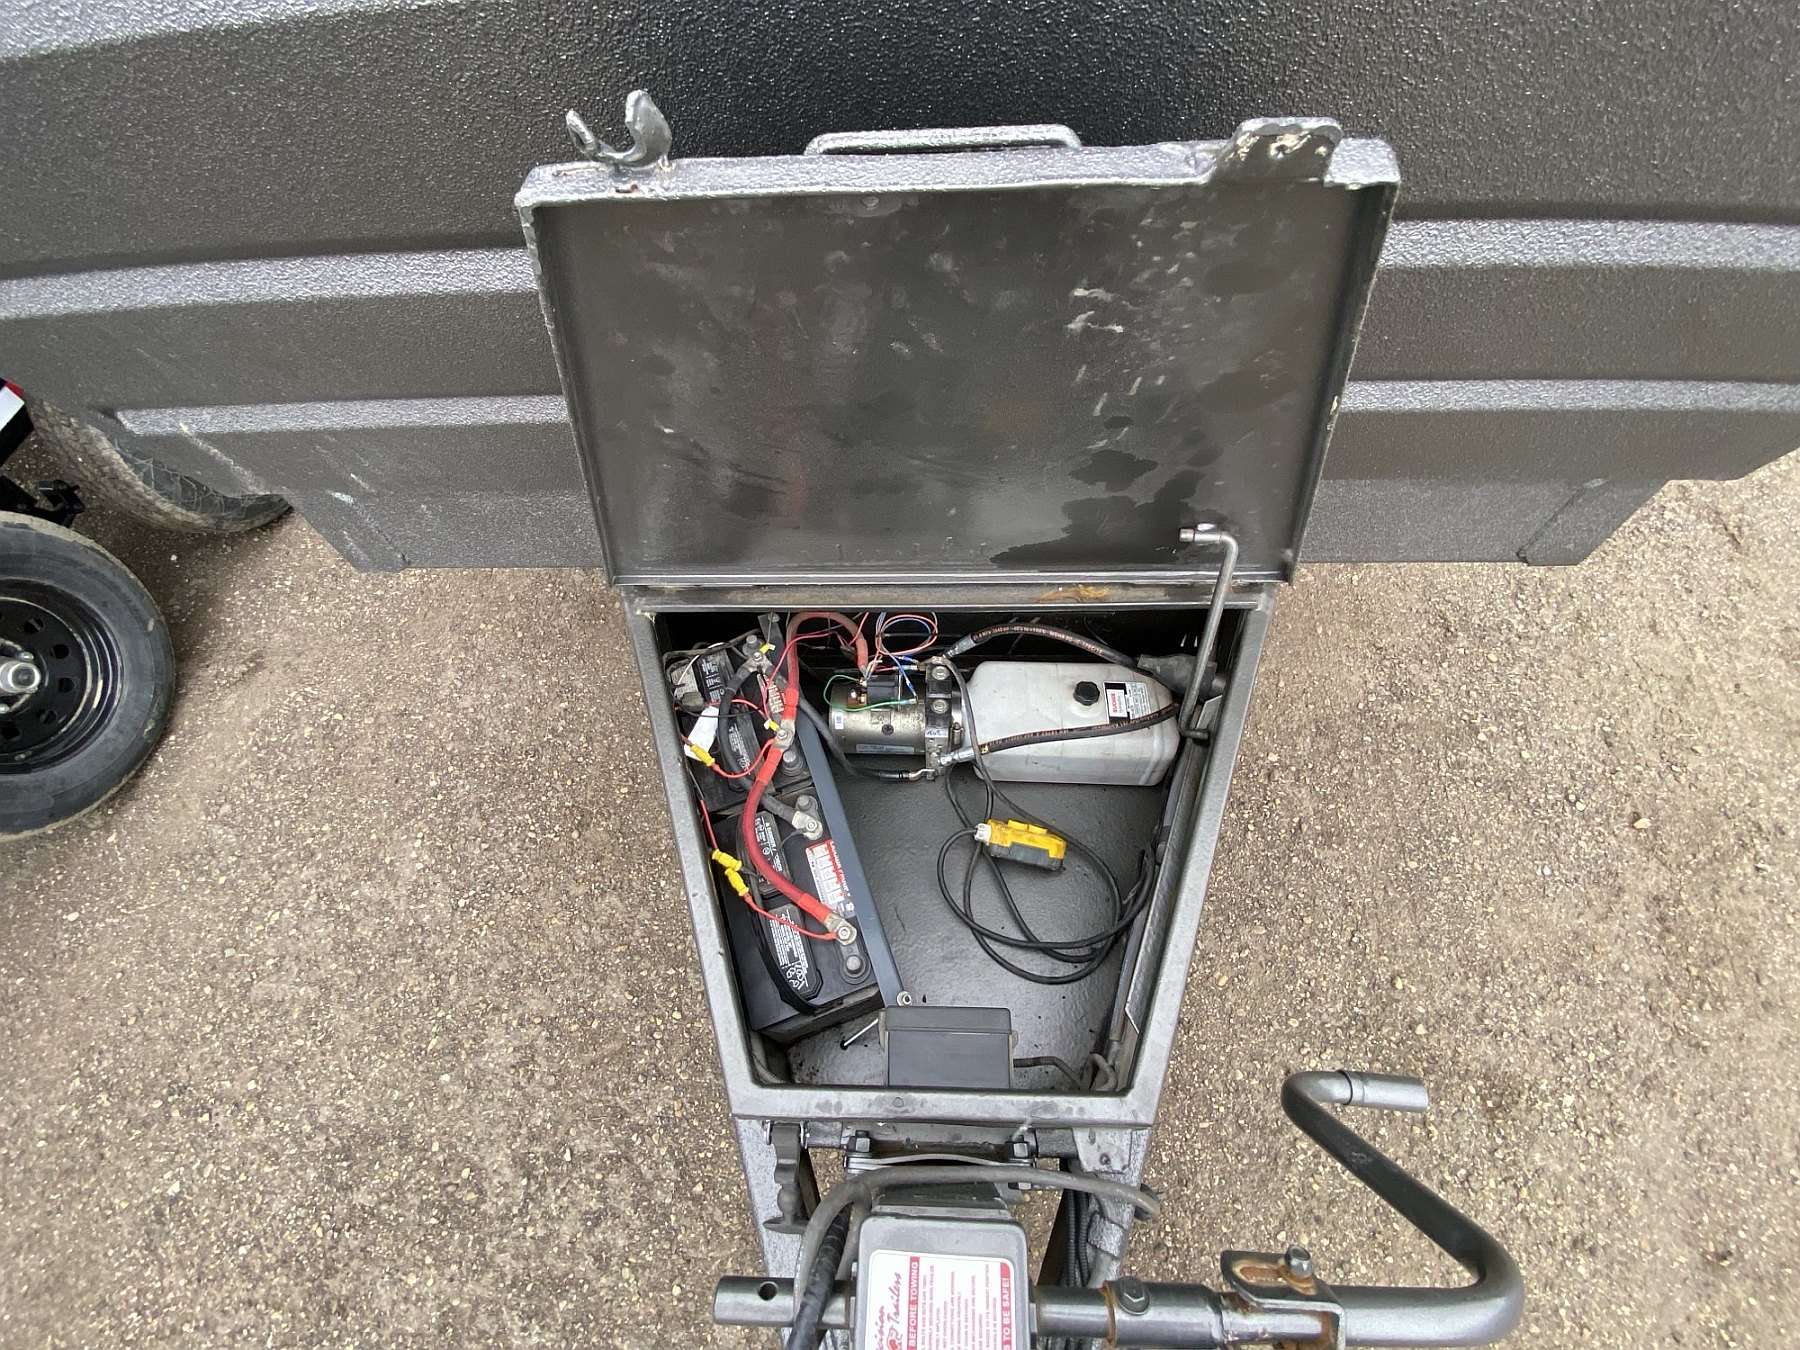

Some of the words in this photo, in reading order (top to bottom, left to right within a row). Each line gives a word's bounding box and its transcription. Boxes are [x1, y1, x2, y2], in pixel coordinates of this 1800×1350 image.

[887, 1272, 902, 1324] Trailers
[910, 1261, 919, 1301] TOWING
[1002, 1278, 1010, 1307] SAFE!
[908, 1304, 918, 1347] BEFORE
[1003, 1309, 1010, 1324] BE
[1003, 1327, 1010, 1342] TO
